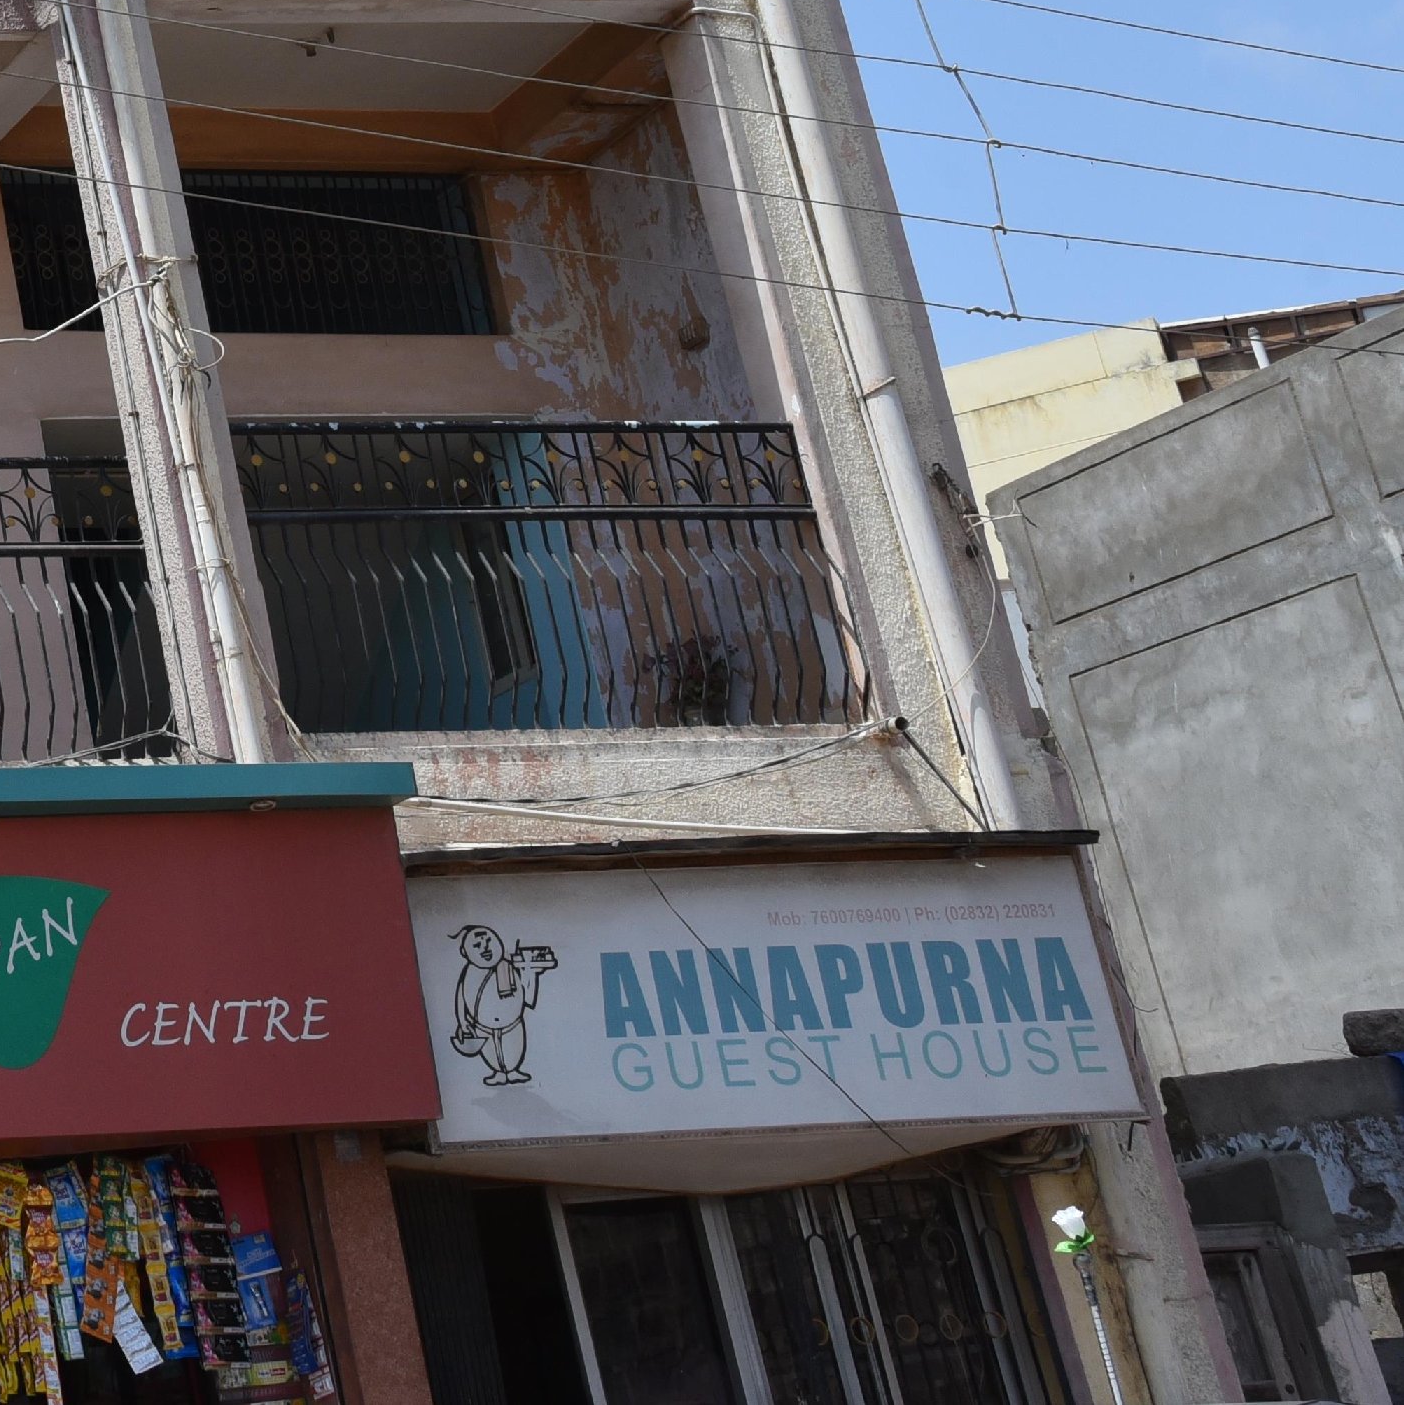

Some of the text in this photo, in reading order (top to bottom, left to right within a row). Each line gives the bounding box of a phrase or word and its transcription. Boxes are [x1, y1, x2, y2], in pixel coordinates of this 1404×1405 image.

[810, 908, 901, 925] 7600769400
[945, 904, 1000, 924] (02832)
[1004, 903, 1057, 919] 220831
[599, 936, 1093, 1039] ANNAPURNA
[120, 997, 330, 1047] CENTRE
[611, 1025, 1108, 1093] GUEST HOUSE
